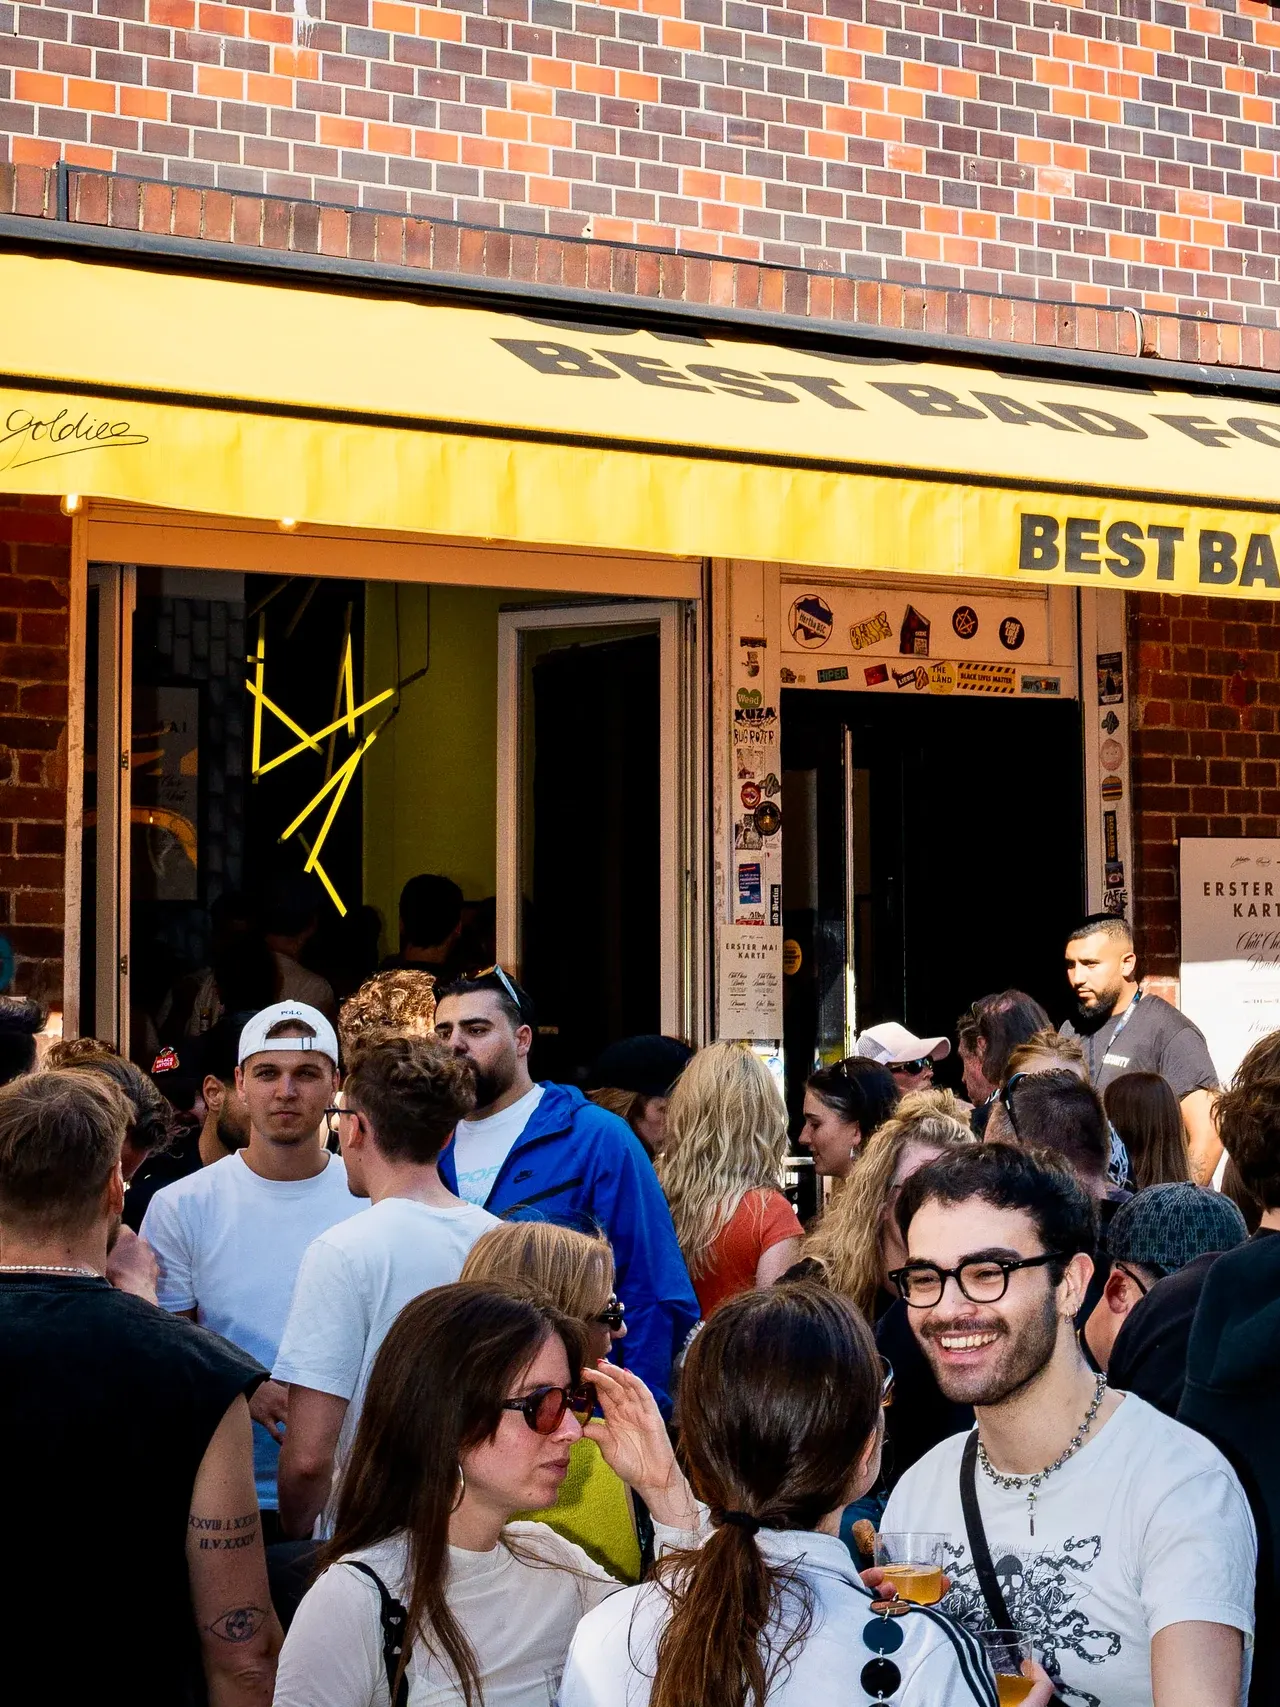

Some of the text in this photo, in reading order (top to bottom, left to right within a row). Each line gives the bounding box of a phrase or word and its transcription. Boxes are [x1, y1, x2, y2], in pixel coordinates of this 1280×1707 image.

[492, 337, 867, 411] BEST
[866, 382, 1149, 440] BAD
[1019, 512, 1185, 580] BEST
[799, 613, 827, 634] Hertha BSC
[932, 666, 947, 674] THE
[960, 672, 1013, 685] BLACK LIVES MATTER
[734, 706, 776, 720] KUZA
[1203, 881, 1274, 896] ERSTER
[725, 943, 778, 951] ERSTER MAI
[738, 952, 766, 960] KARTE
